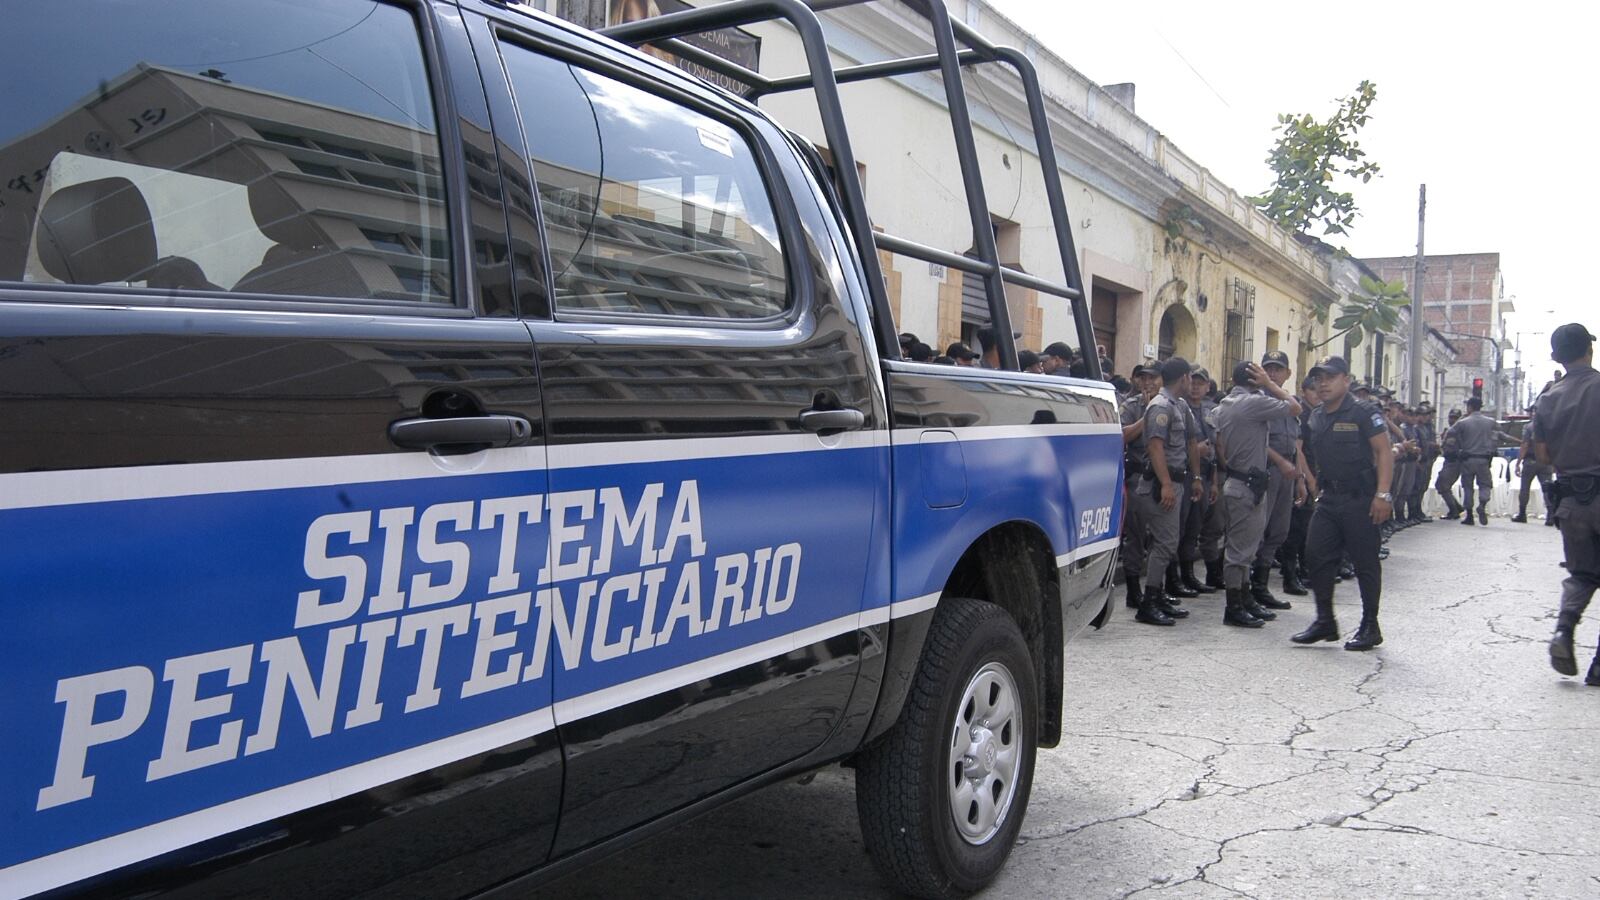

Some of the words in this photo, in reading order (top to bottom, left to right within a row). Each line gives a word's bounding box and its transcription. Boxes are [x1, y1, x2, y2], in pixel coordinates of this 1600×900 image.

[679, 58, 751, 94] COSMETOLOG
[294, 479, 706, 629] SISTEMA
[1080, 506, 1110, 538] SP-006
[37, 542, 802, 811] PENITENCIARIO
